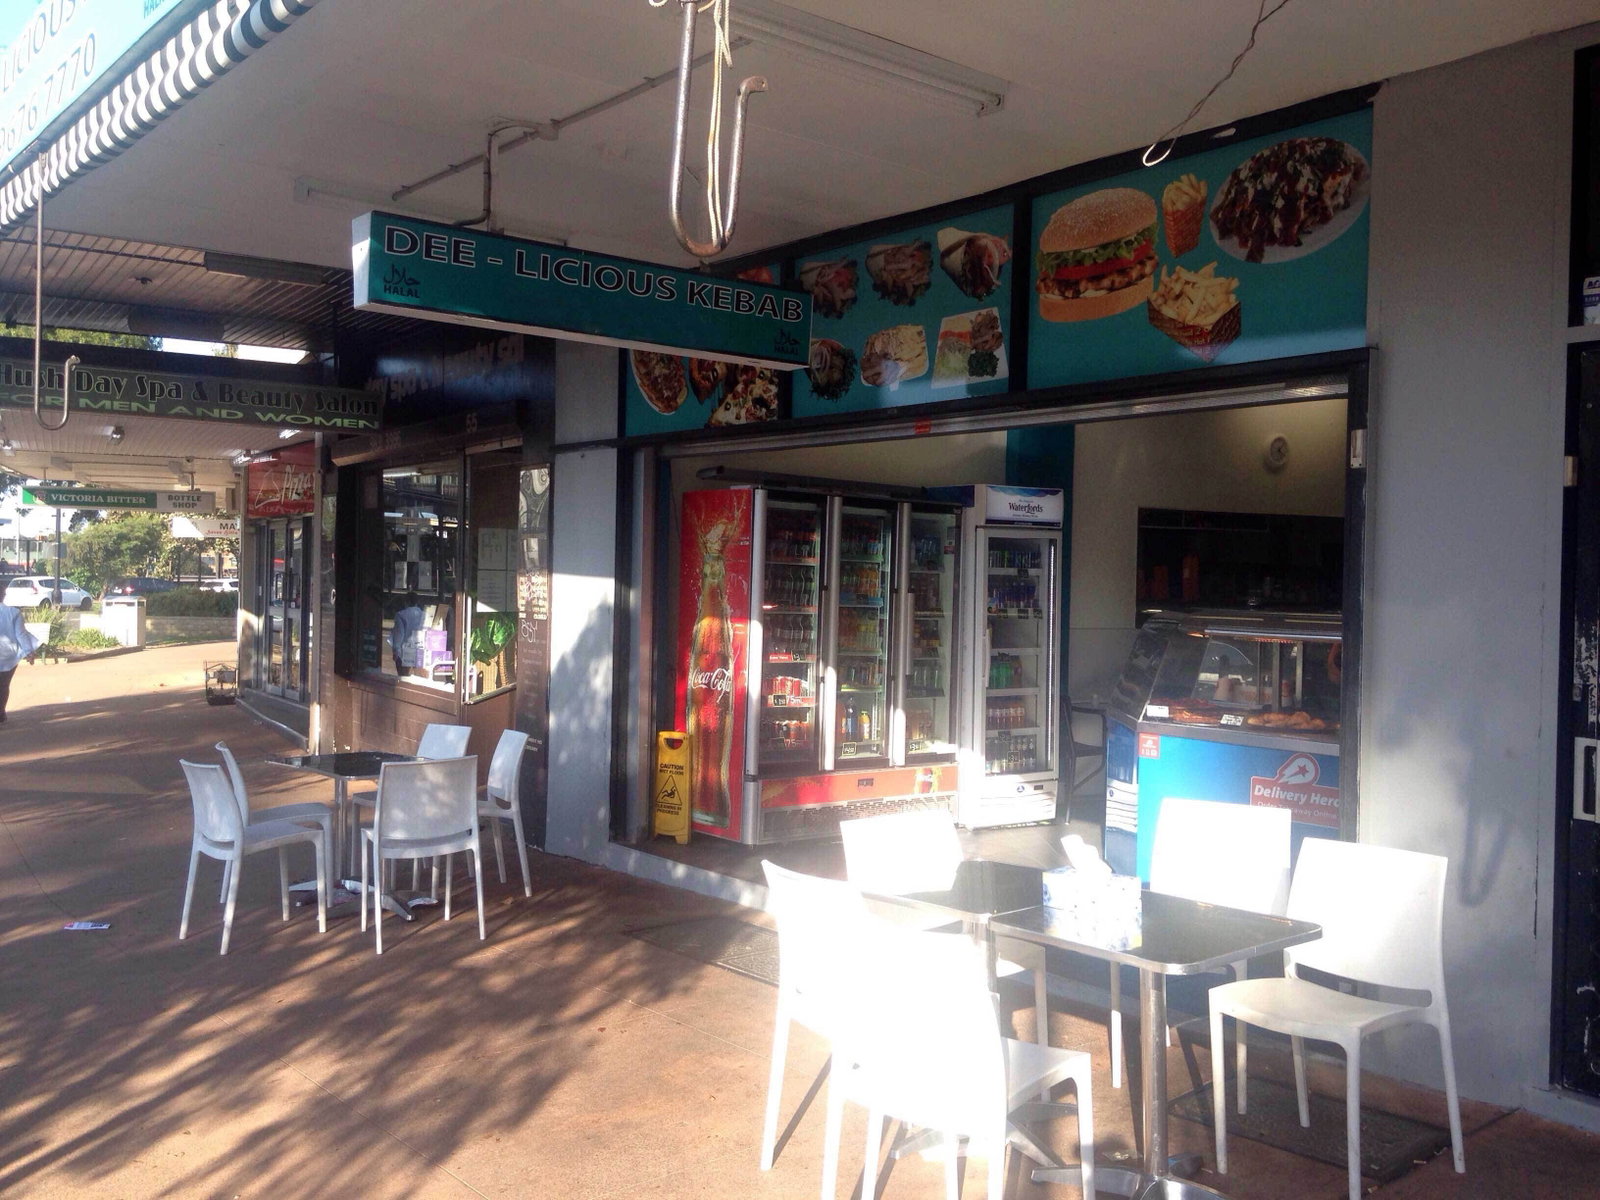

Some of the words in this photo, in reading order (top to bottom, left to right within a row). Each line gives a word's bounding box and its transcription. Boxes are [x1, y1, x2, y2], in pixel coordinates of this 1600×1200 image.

[384, 225, 476, 268] DEE
[487, 256, 503, 266] -
[515, 249, 677, 301] LICIOUS
[687, 280, 803, 323] KEBAB
[384, 284, 420, 299] HALAL
[75, 369, 128, 399] Day
[136, 375, 183, 402] Spa
[191, 381, 209, 403] &
[218, 383, 304, 413] Beauty
[314, 391, 379, 416] Salon
[79, 400, 156, 413] MEN
[167, 405, 244, 419] AND
[255, 411, 380, 430] WOMEN
[51, 493, 104, 503] VICTORIA
[105, 495, 147, 504] BITTER
[168, 494, 202, 502] BOTTLE
[172, 501, 198, 509] SHOP
[660, 763, 684, 771] CAUTION
[1254, 784, 1308, 805] Delivery
[1310, 792, 1341, 808] Hero
